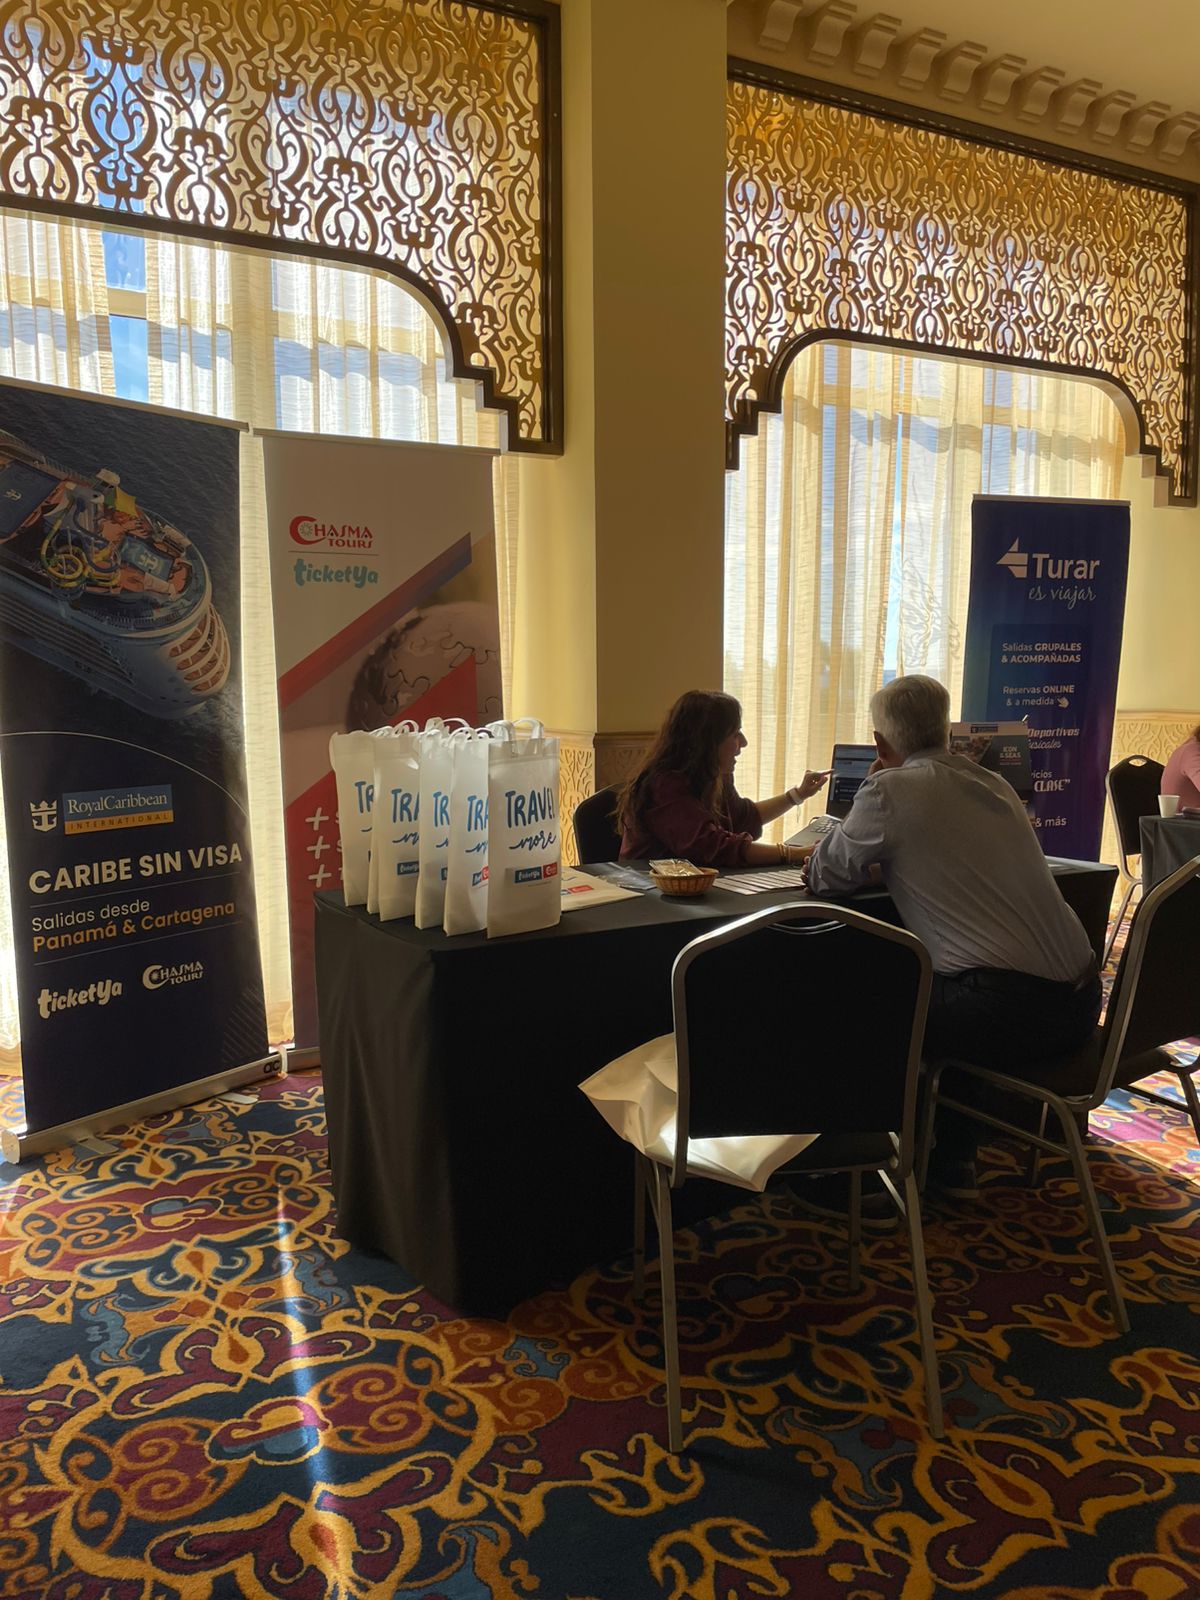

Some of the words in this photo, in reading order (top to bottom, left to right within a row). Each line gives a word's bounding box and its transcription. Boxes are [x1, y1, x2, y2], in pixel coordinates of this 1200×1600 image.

[289, 516, 373, 545] CHASMA
[328, 539, 373, 548] TOURS
[1032, 553, 1100, 580] Turar
[1028, 586, 1046, 601] es
[1050, 584, 1097, 610] viajar
[1002, 643, 1033, 652] Salidas
[1034, 643, 1082, 652] GRUPALES
[1001, 655, 1008, 663] &
[1011, 652, 1081, 663] ACOMPAÑADAS
[1003, 686, 1041, 695] Reservas
[1043, 685, 1075, 694] ONLINE
[1006, 698, 1012, 706] &
[1022, 697, 1055, 706] medida
[1027, 728, 1080, 738] Deportivos
[1028, 739, 1063, 749] usicales
[70, 813, 170, 831] INTERNATIONAL
[1045, 816, 1067, 827] más
[509, 830, 556, 851] more
[29, 858, 133, 894] CARIBE
[139, 851, 182, 877] SIN
[188, 843, 243, 869] VISA
[32, 908, 95, 932] Salidas
[100, 899, 150, 919] desde
[33, 920, 117, 952] Panamá
[122, 919, 136, 935] &
[141, 902, 236, 930] Cartagena
[142, 961, 204, 990] CHASMA
[170, 971, 204, 985] TOURS
